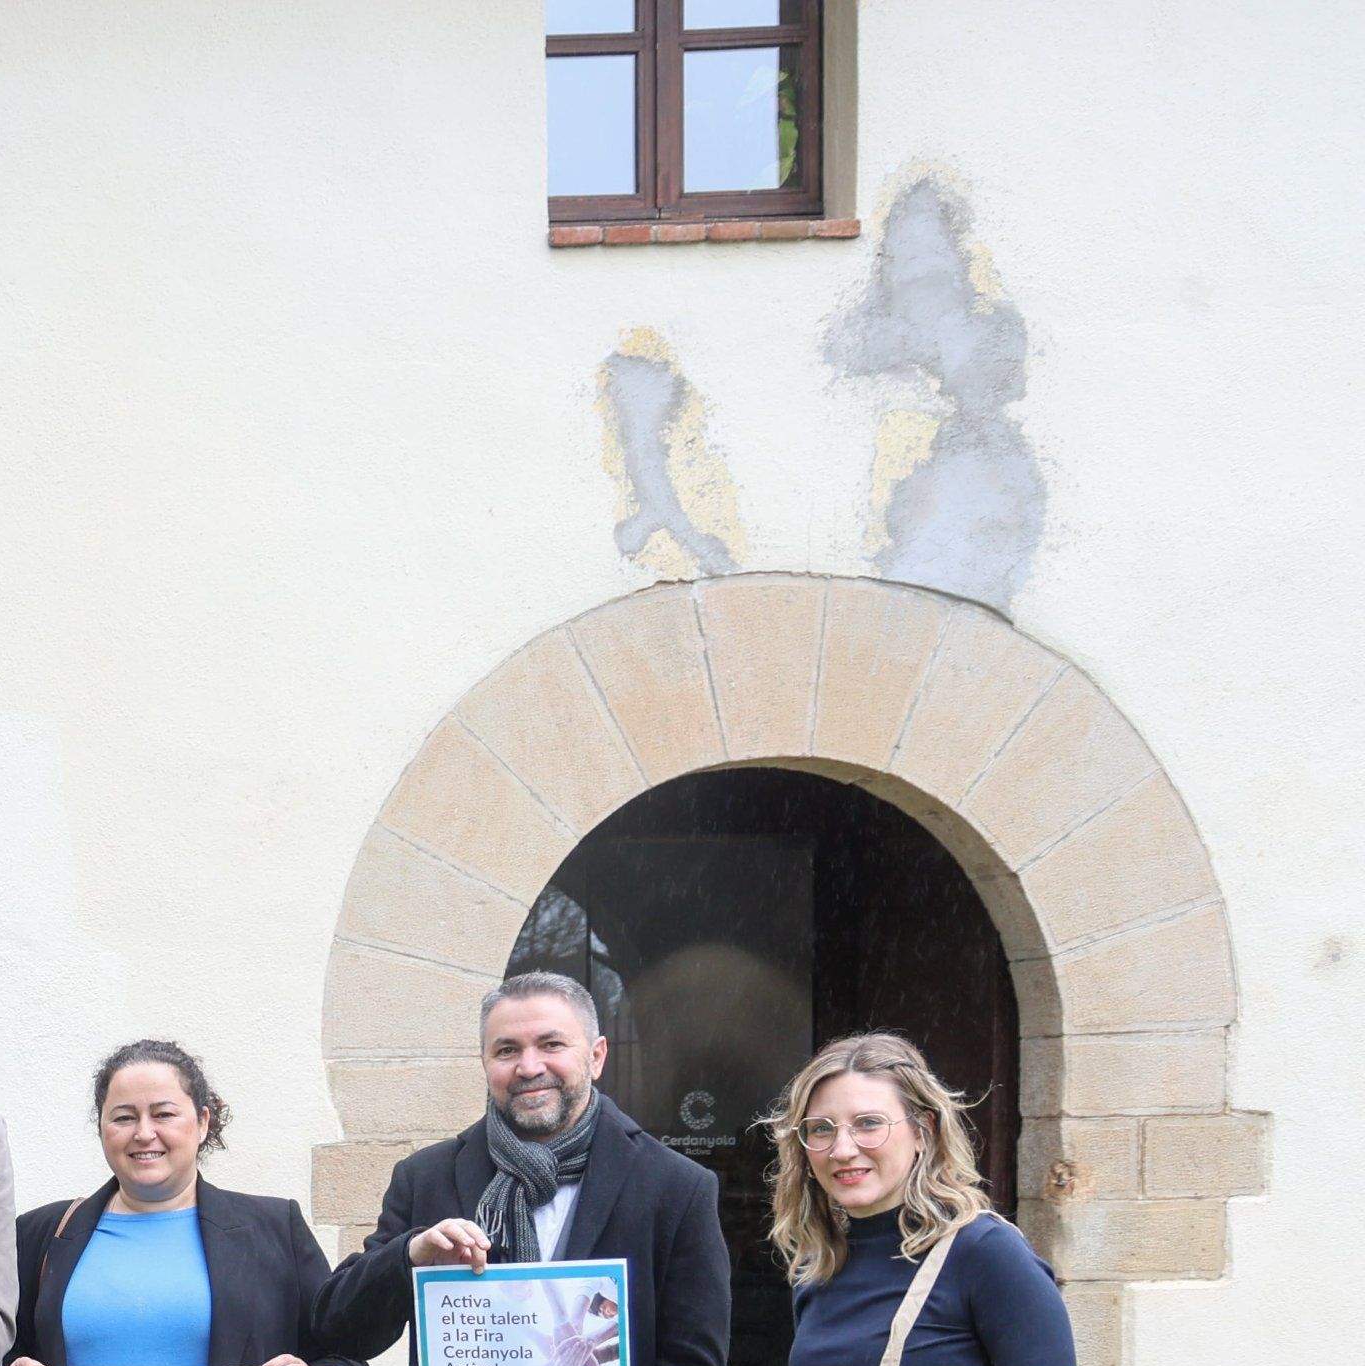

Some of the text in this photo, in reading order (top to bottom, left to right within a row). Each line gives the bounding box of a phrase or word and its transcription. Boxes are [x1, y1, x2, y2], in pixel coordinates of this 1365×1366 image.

[661, 1135, 736, 1148] Cerdanyola
[441, 1294, 491, 1308] Activa
[442, 1312, 537, 1325] el teu talent
[442, 1329, 504, 1342] a la Fira
[444, 1345, 533, 1362] Cerdanyola
